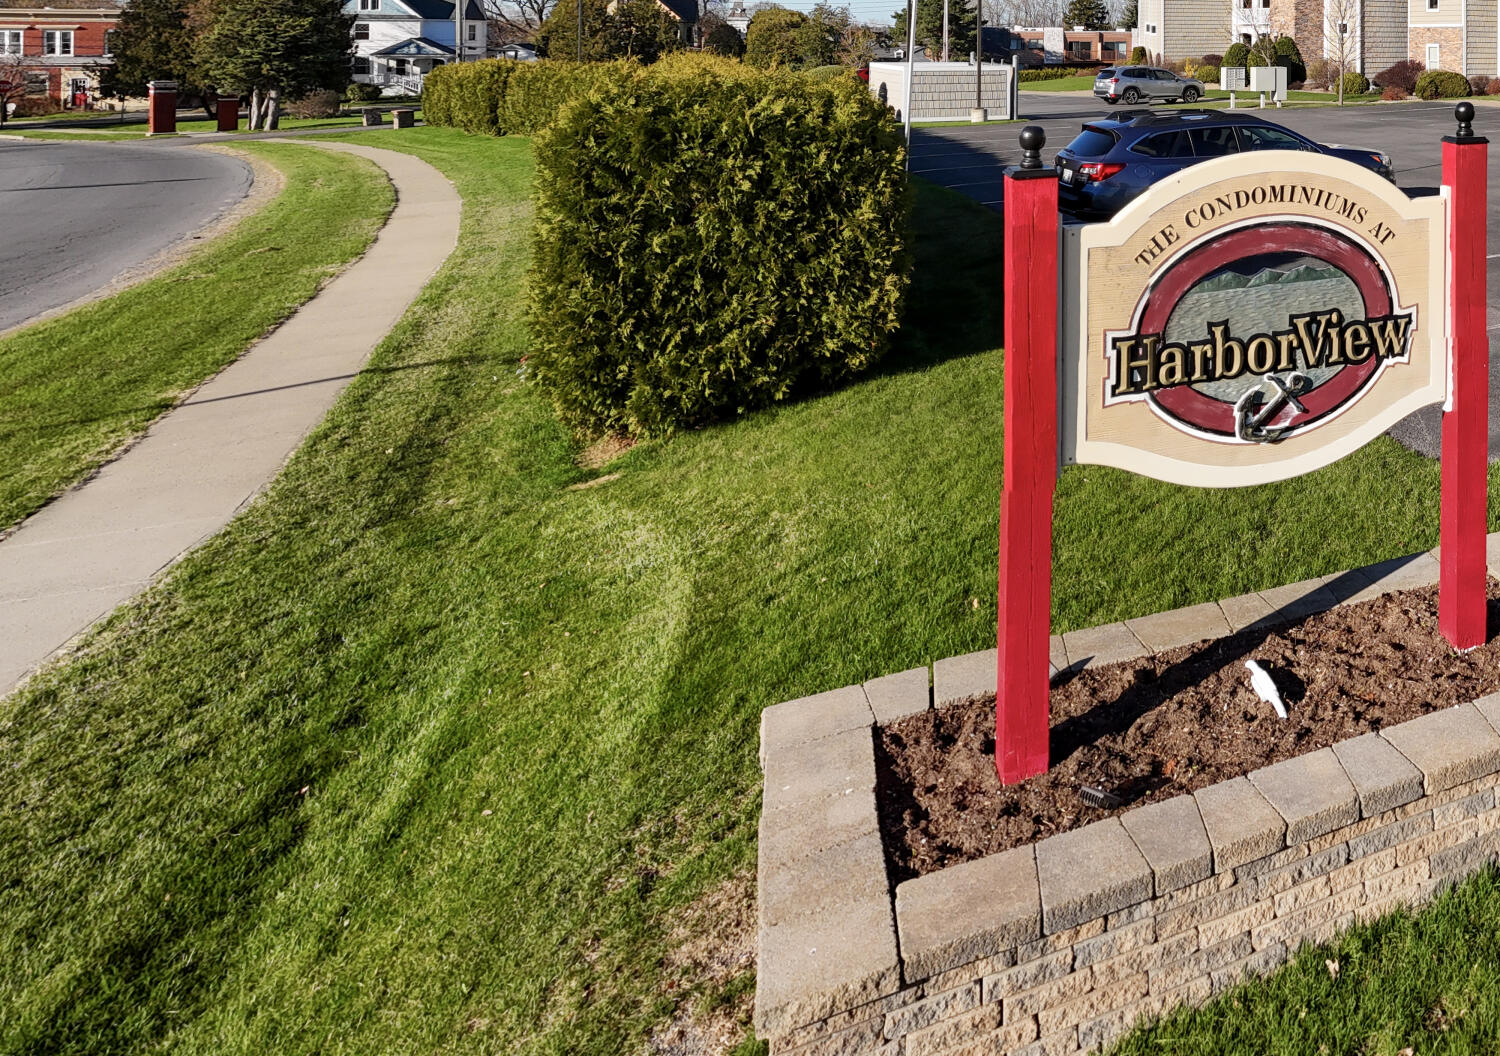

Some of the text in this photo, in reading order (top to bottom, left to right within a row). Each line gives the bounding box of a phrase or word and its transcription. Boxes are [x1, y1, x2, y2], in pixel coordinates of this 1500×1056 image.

[1134, 184, 1396, 266] THE CONDOMINIUMS AT
[1113, 310, 1412, 395] HarborView
